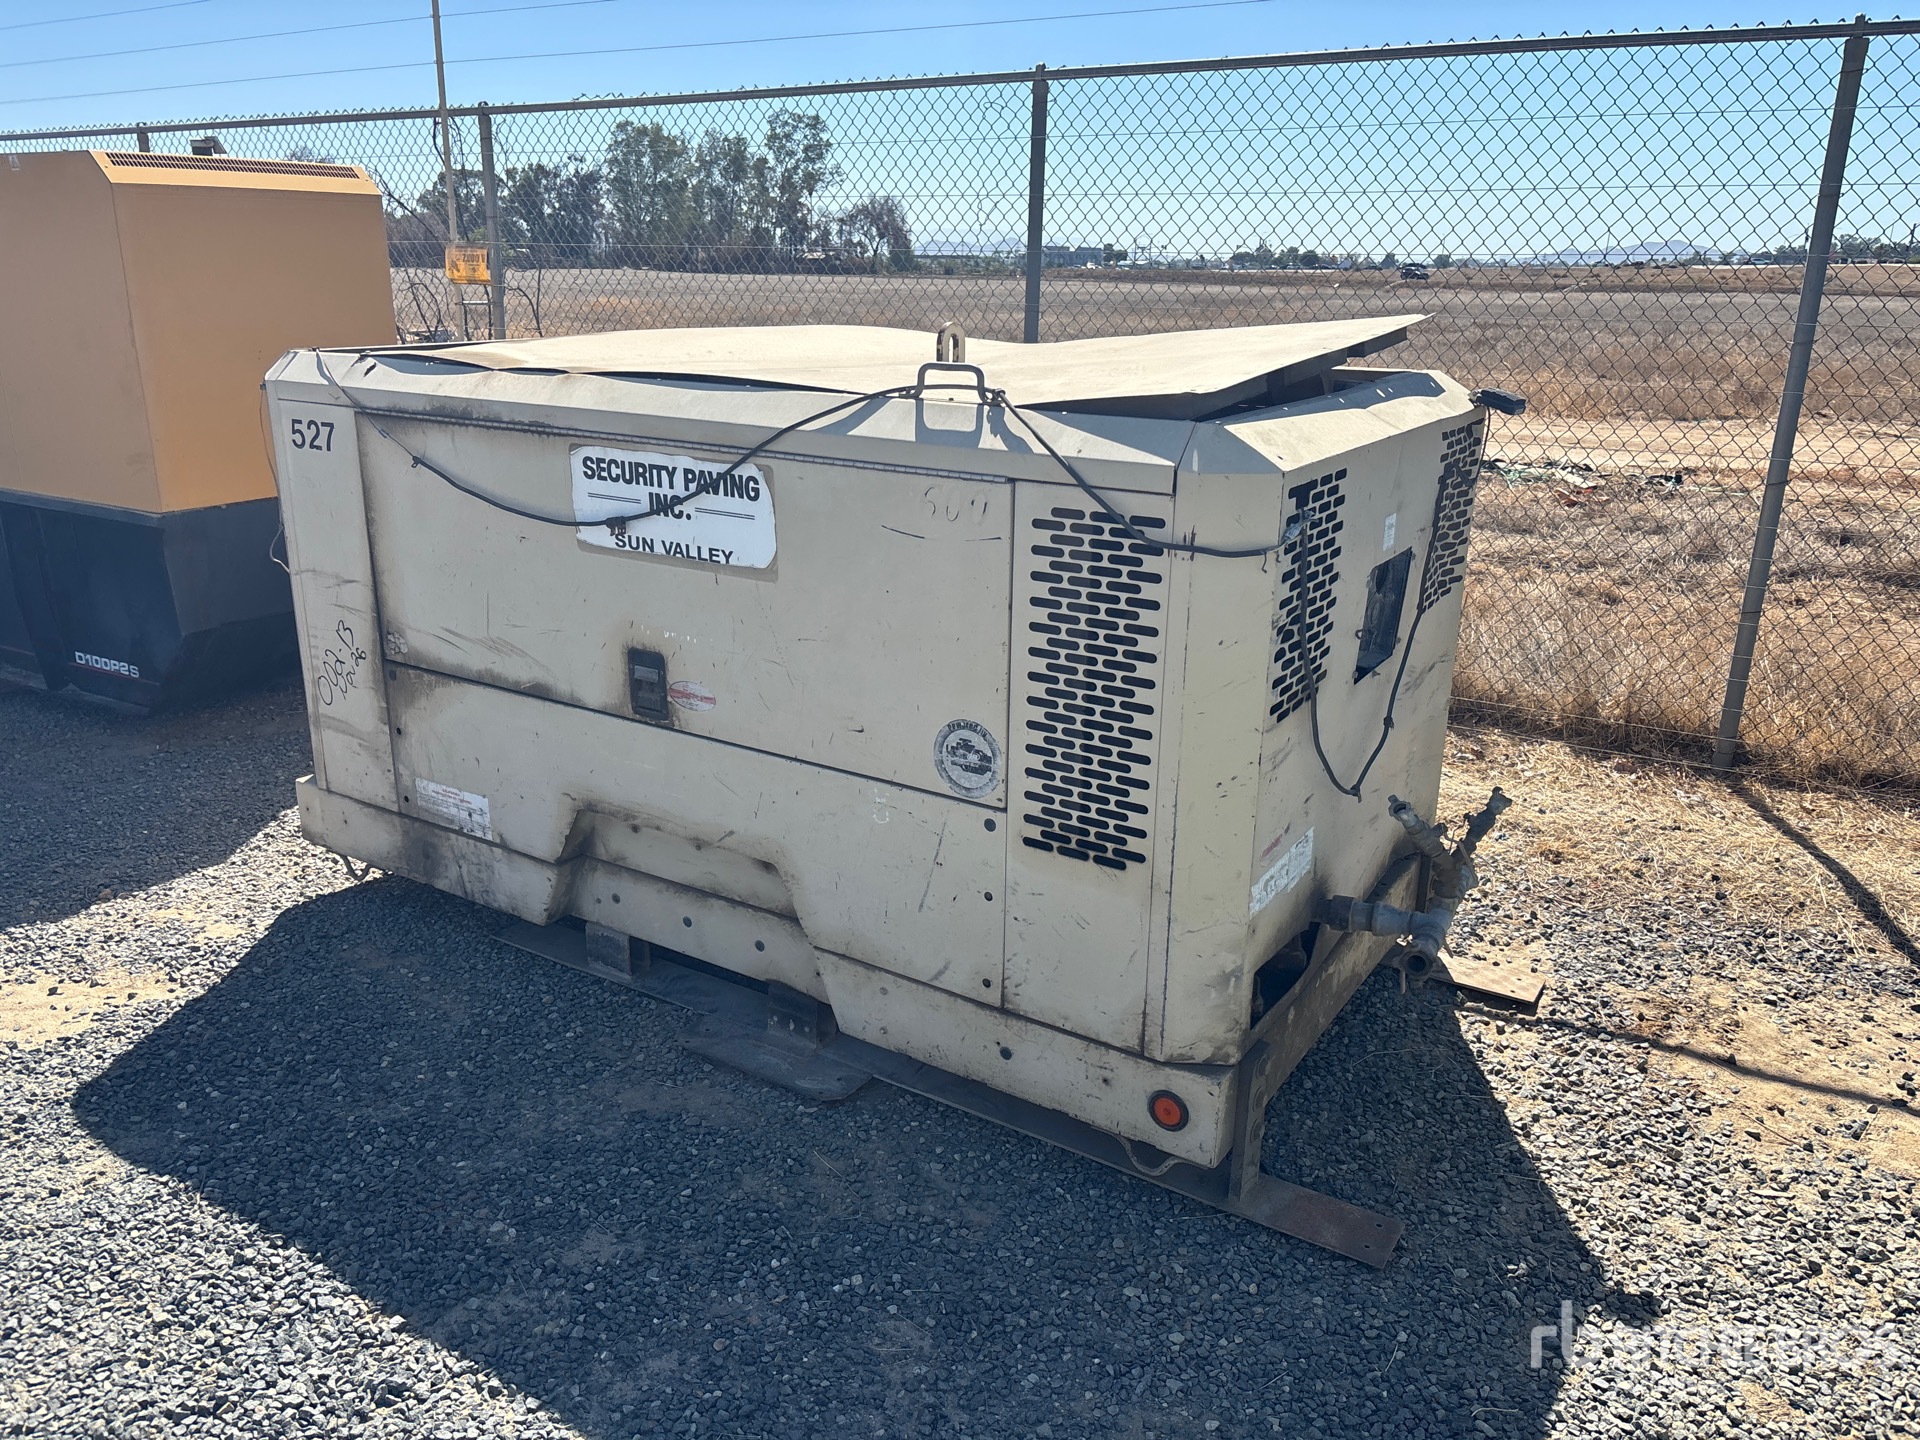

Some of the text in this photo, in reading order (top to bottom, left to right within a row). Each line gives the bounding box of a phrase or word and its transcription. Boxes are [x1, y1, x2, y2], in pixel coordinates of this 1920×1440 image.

[291, 418, 335, 452] 527
[582, 455, 760, 502] SECURITY PAVING
[648, 491, 692, 521] INC.
[615, 533, 734, 565] SUN VALLEY
[74, 651, 140, 679] D100P2S
